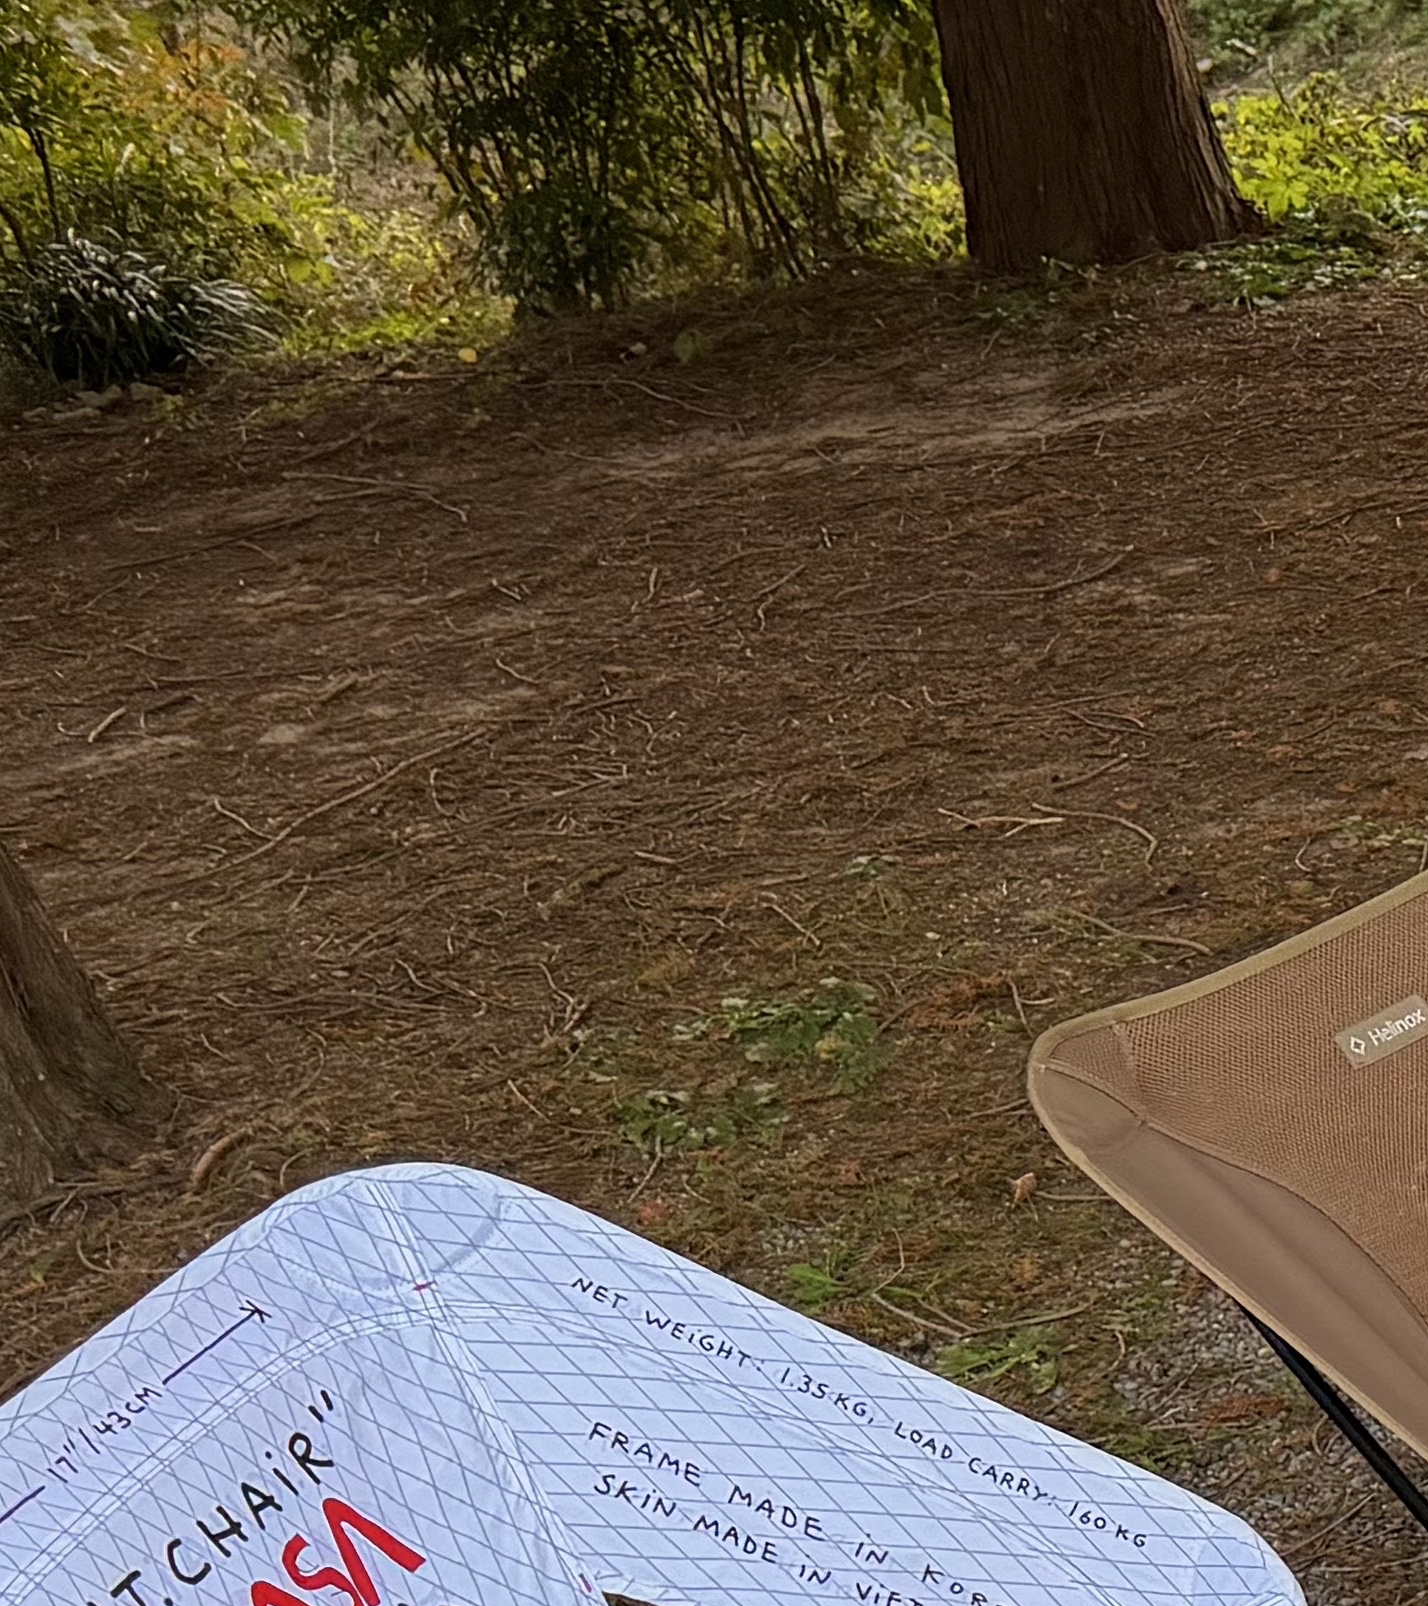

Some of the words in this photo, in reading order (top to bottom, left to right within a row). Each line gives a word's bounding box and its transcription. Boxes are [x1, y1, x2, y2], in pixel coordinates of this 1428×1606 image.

[1367, 1008, 1426, 1047] Helinox
[571, 1277, 628, 1309] NET
[895, 1422, 953, 1460] LOAD
[968, 1457, 1057, 1507] CARRY:
[588, 1422, 700, 1487] FRAME
[727, 1485, 825, 1541] MADE
[854, 1533, 889, 1564] IN
[593, 1474, 677, 1517] SKIN
[693, 1515, 779, 1564] MADE
[799, 1553, 832, 1585] IN
